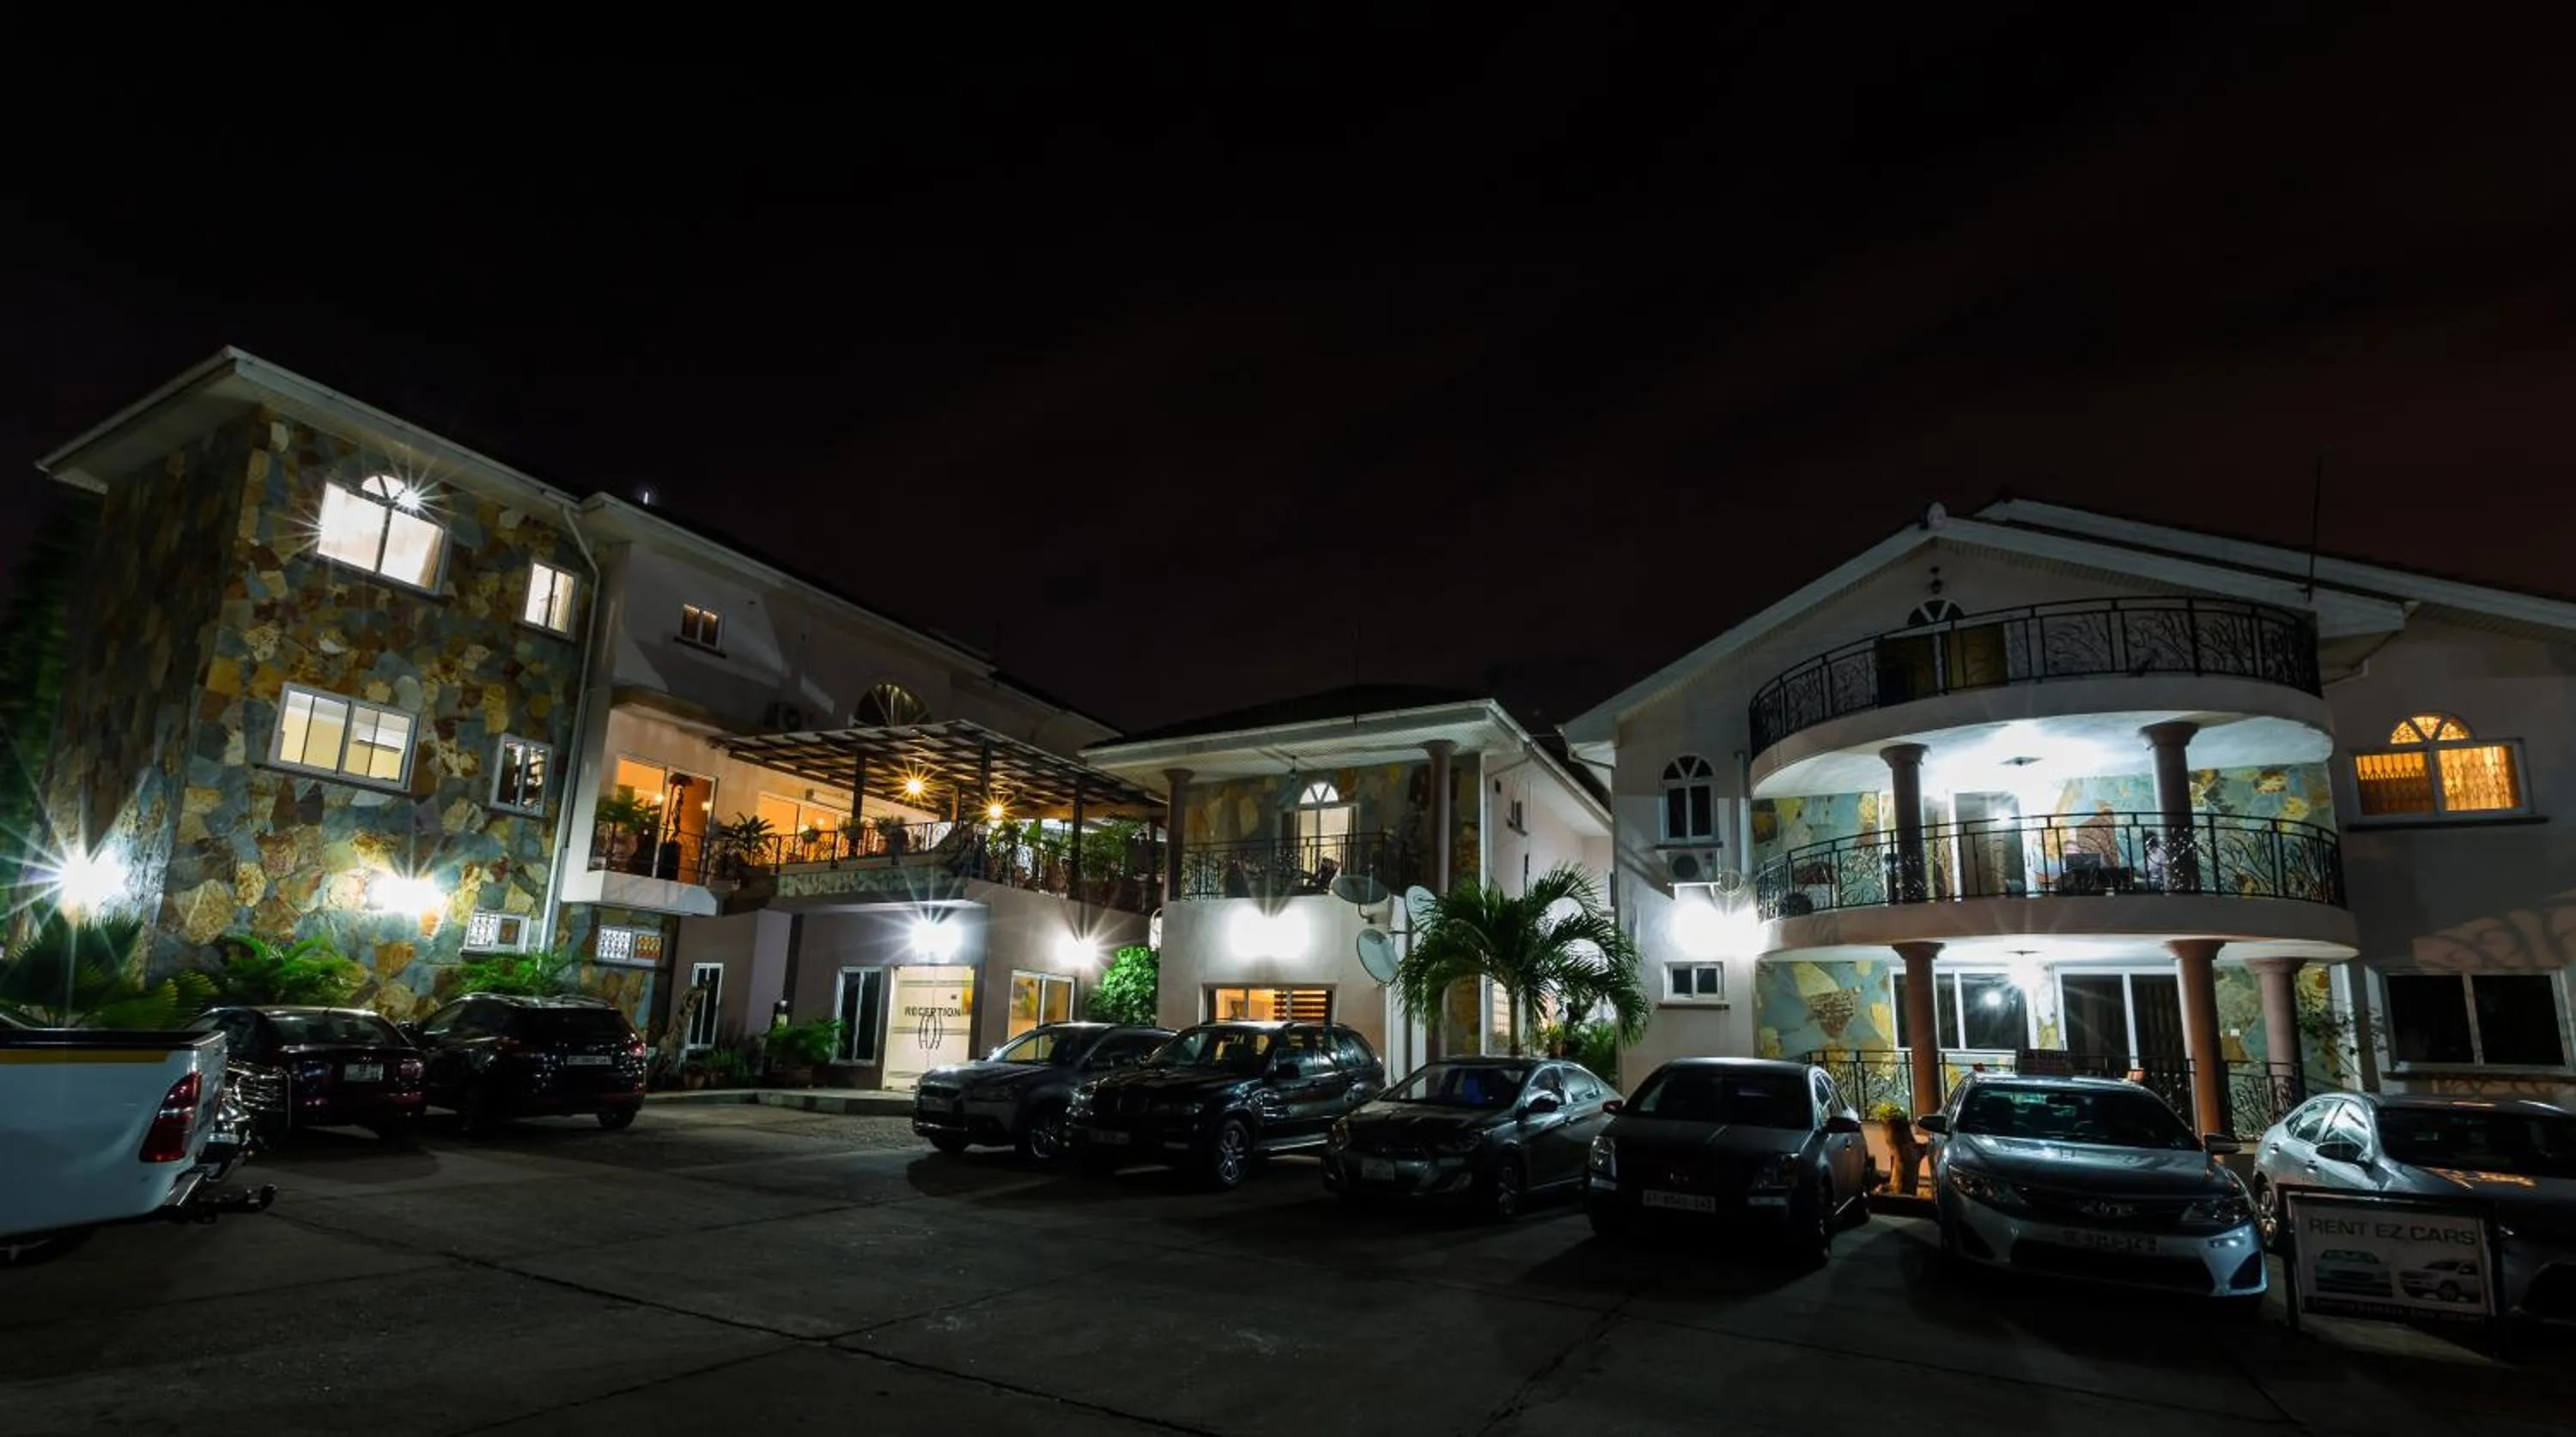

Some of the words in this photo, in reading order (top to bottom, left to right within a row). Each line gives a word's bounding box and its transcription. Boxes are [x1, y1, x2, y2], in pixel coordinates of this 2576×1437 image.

[903, 1006, 962, 1017] RECEPTION
[2308, 1217, 2367, 1237] RENT
[2375, 1223, 2403, 1239] EZ
[2409, 1227, 2476, 1246] CARS
